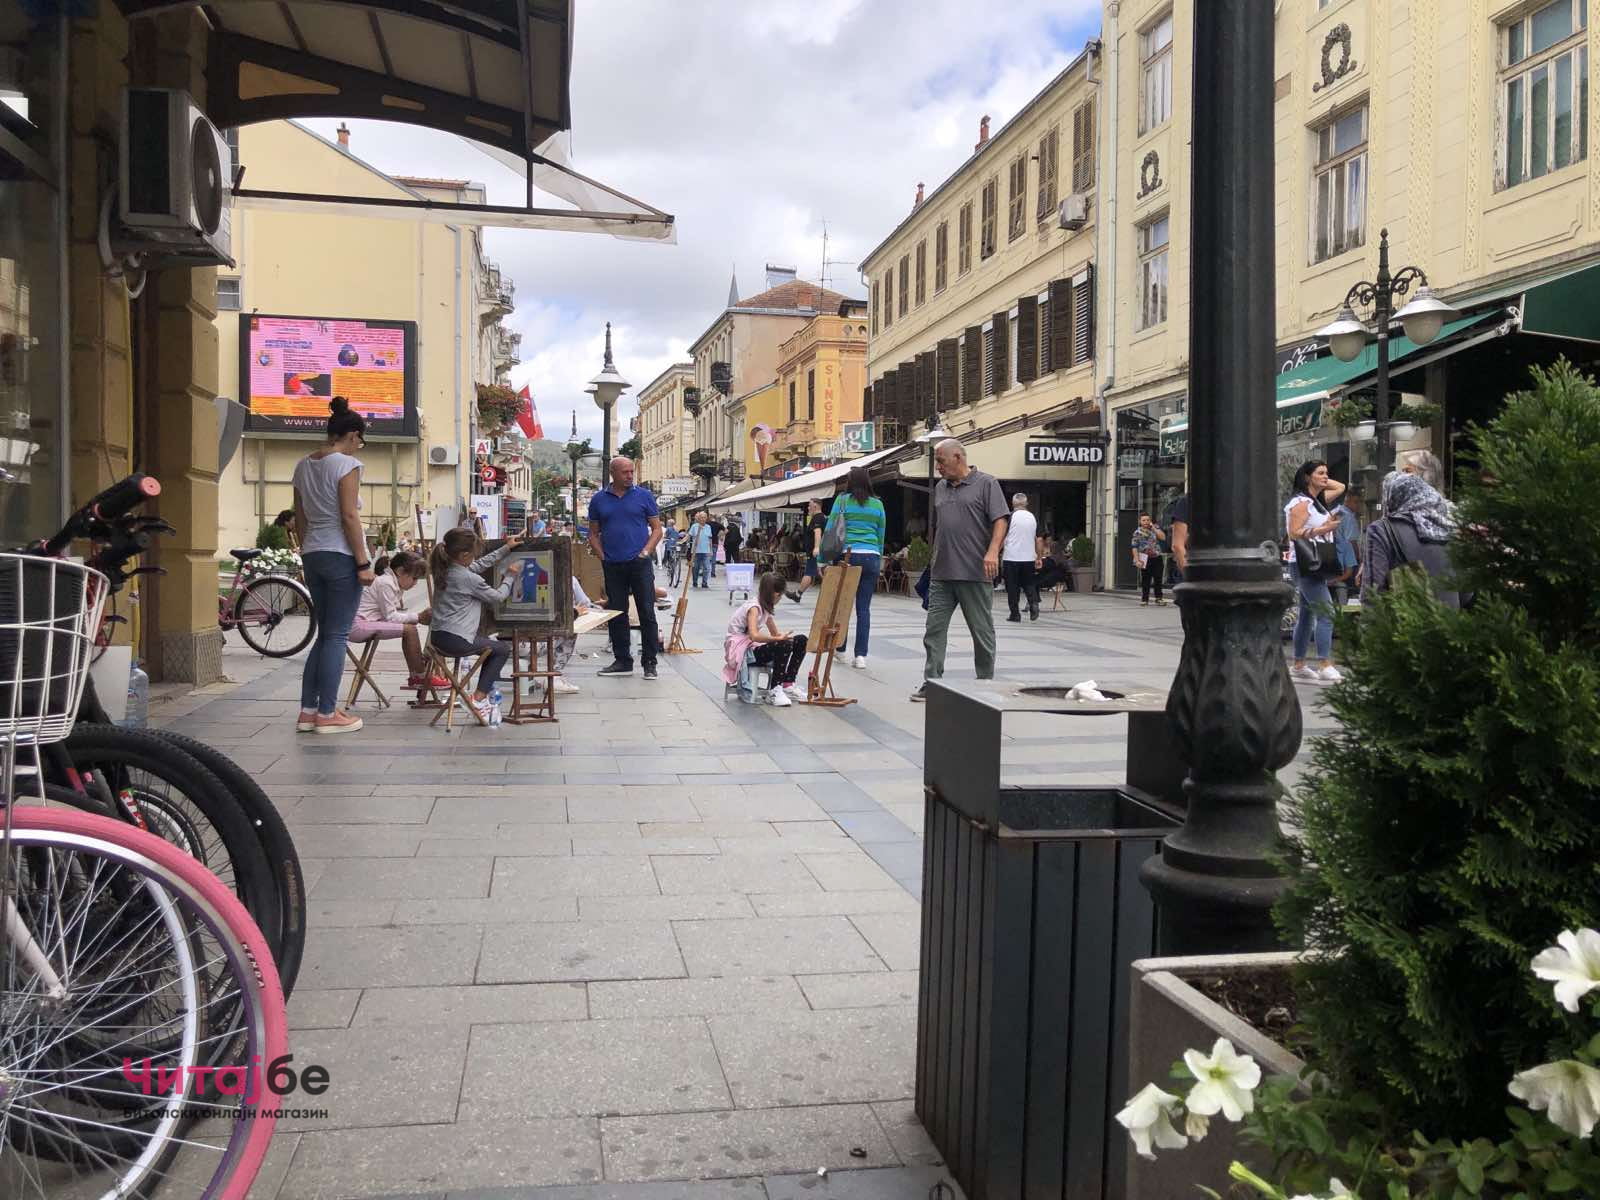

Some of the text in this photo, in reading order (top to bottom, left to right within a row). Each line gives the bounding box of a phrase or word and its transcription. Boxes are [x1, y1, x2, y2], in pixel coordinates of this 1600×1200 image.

[824, 363, 833, 433] SINGER
[476, 441, 489, 453] A1
[1028, 446, 1103, 462] EDWARD
[241, 942, 265, 989] KENDA
